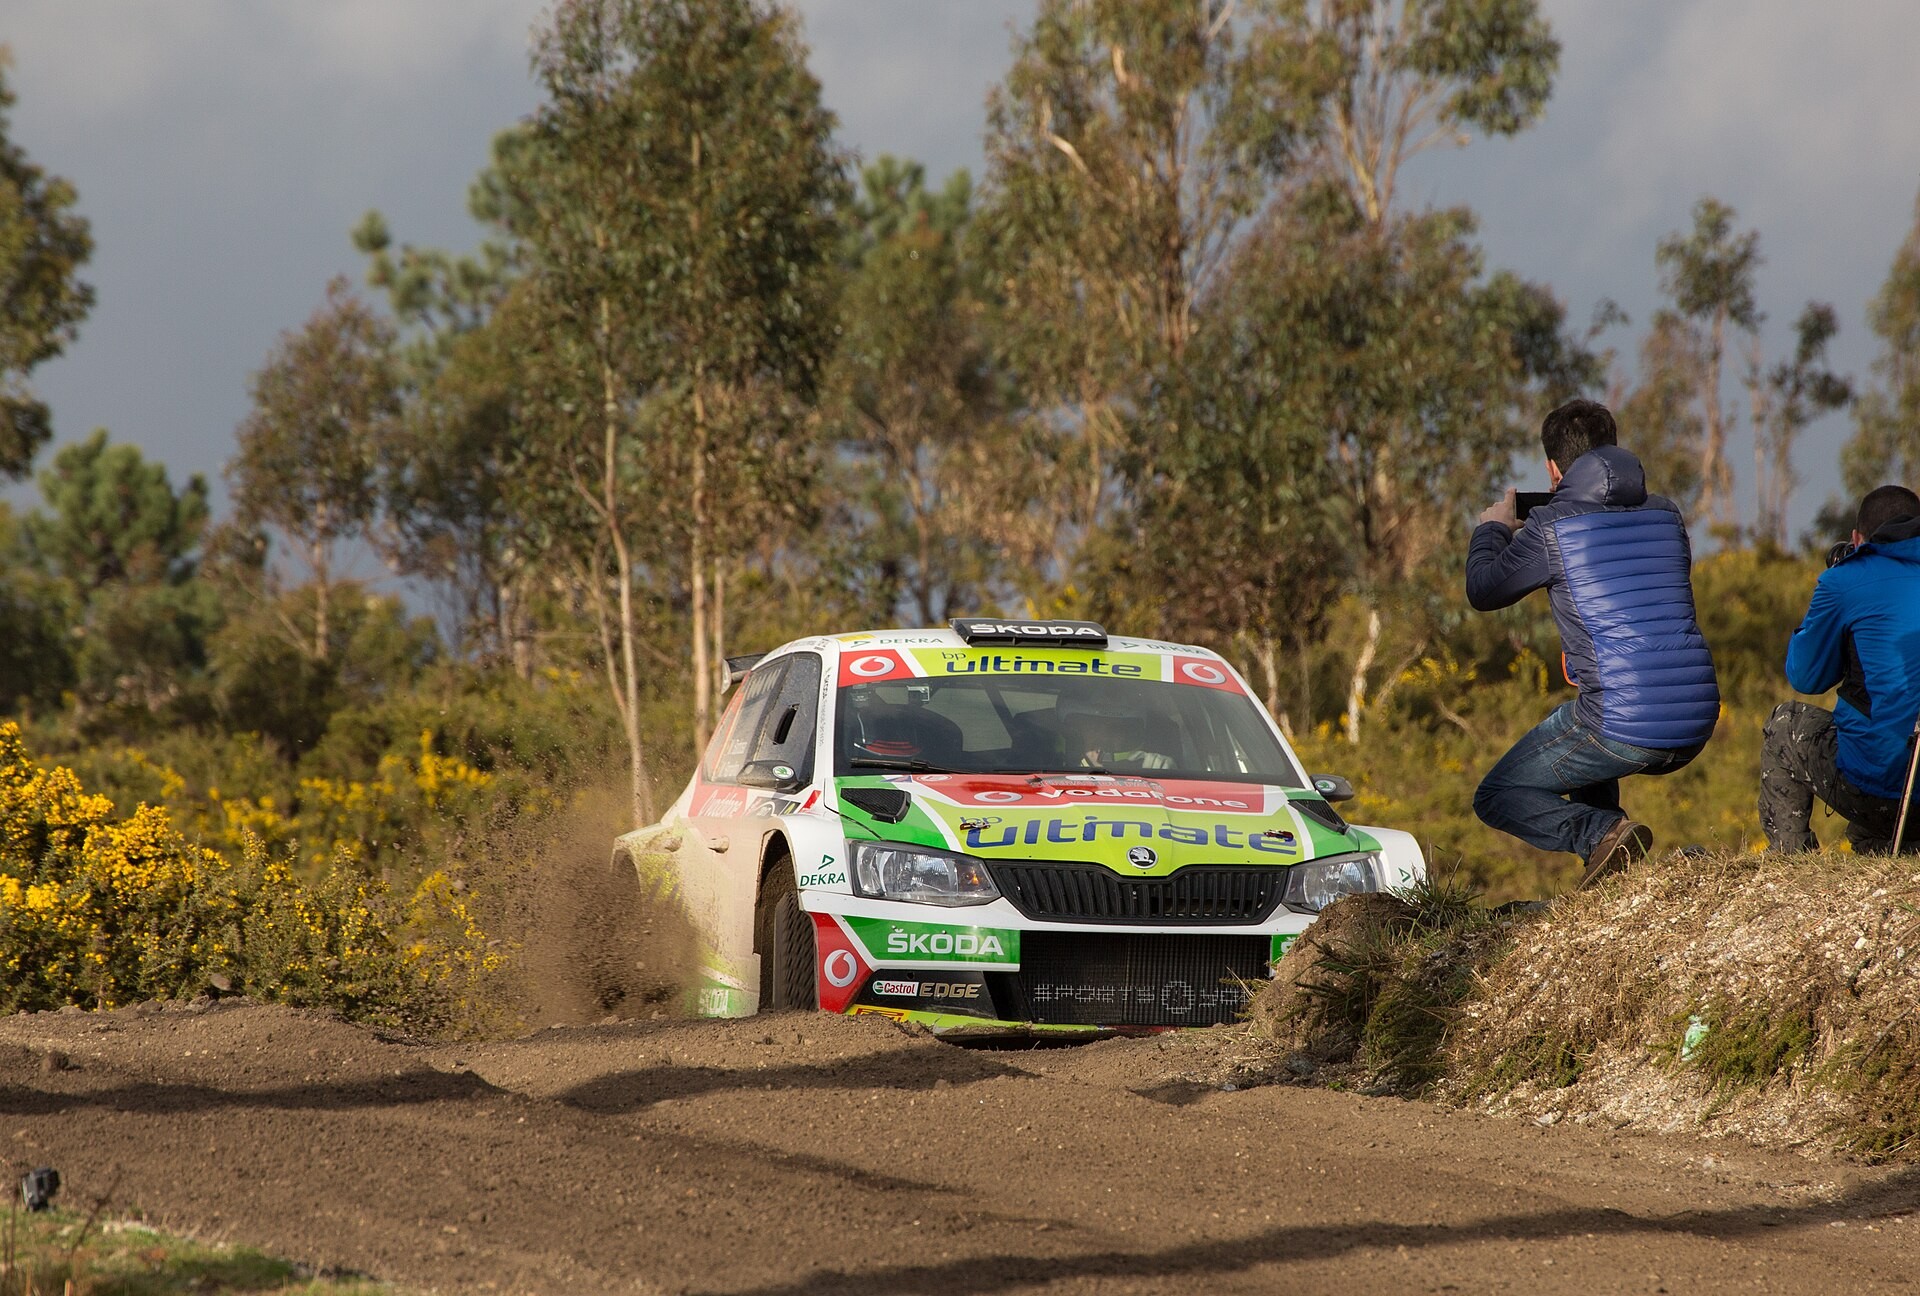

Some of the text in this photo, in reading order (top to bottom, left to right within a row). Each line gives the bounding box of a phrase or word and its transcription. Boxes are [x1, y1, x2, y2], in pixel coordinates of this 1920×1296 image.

[970, 623, 1102, 637] ŠKODA
[942, 652, 966, 660] bp
[946, 655, 1142, 677] ultimate
[1037, 788, 1249, 809] vodafone
[960, 816, 1003, 829] bp
[966, 816, 1297, 856] ultimate
[800, 872, 846, 887] DEKRA
[887, 928, 1005, 956] ŠKODA
[883, 982, 983, 998] Castrol EDGE
